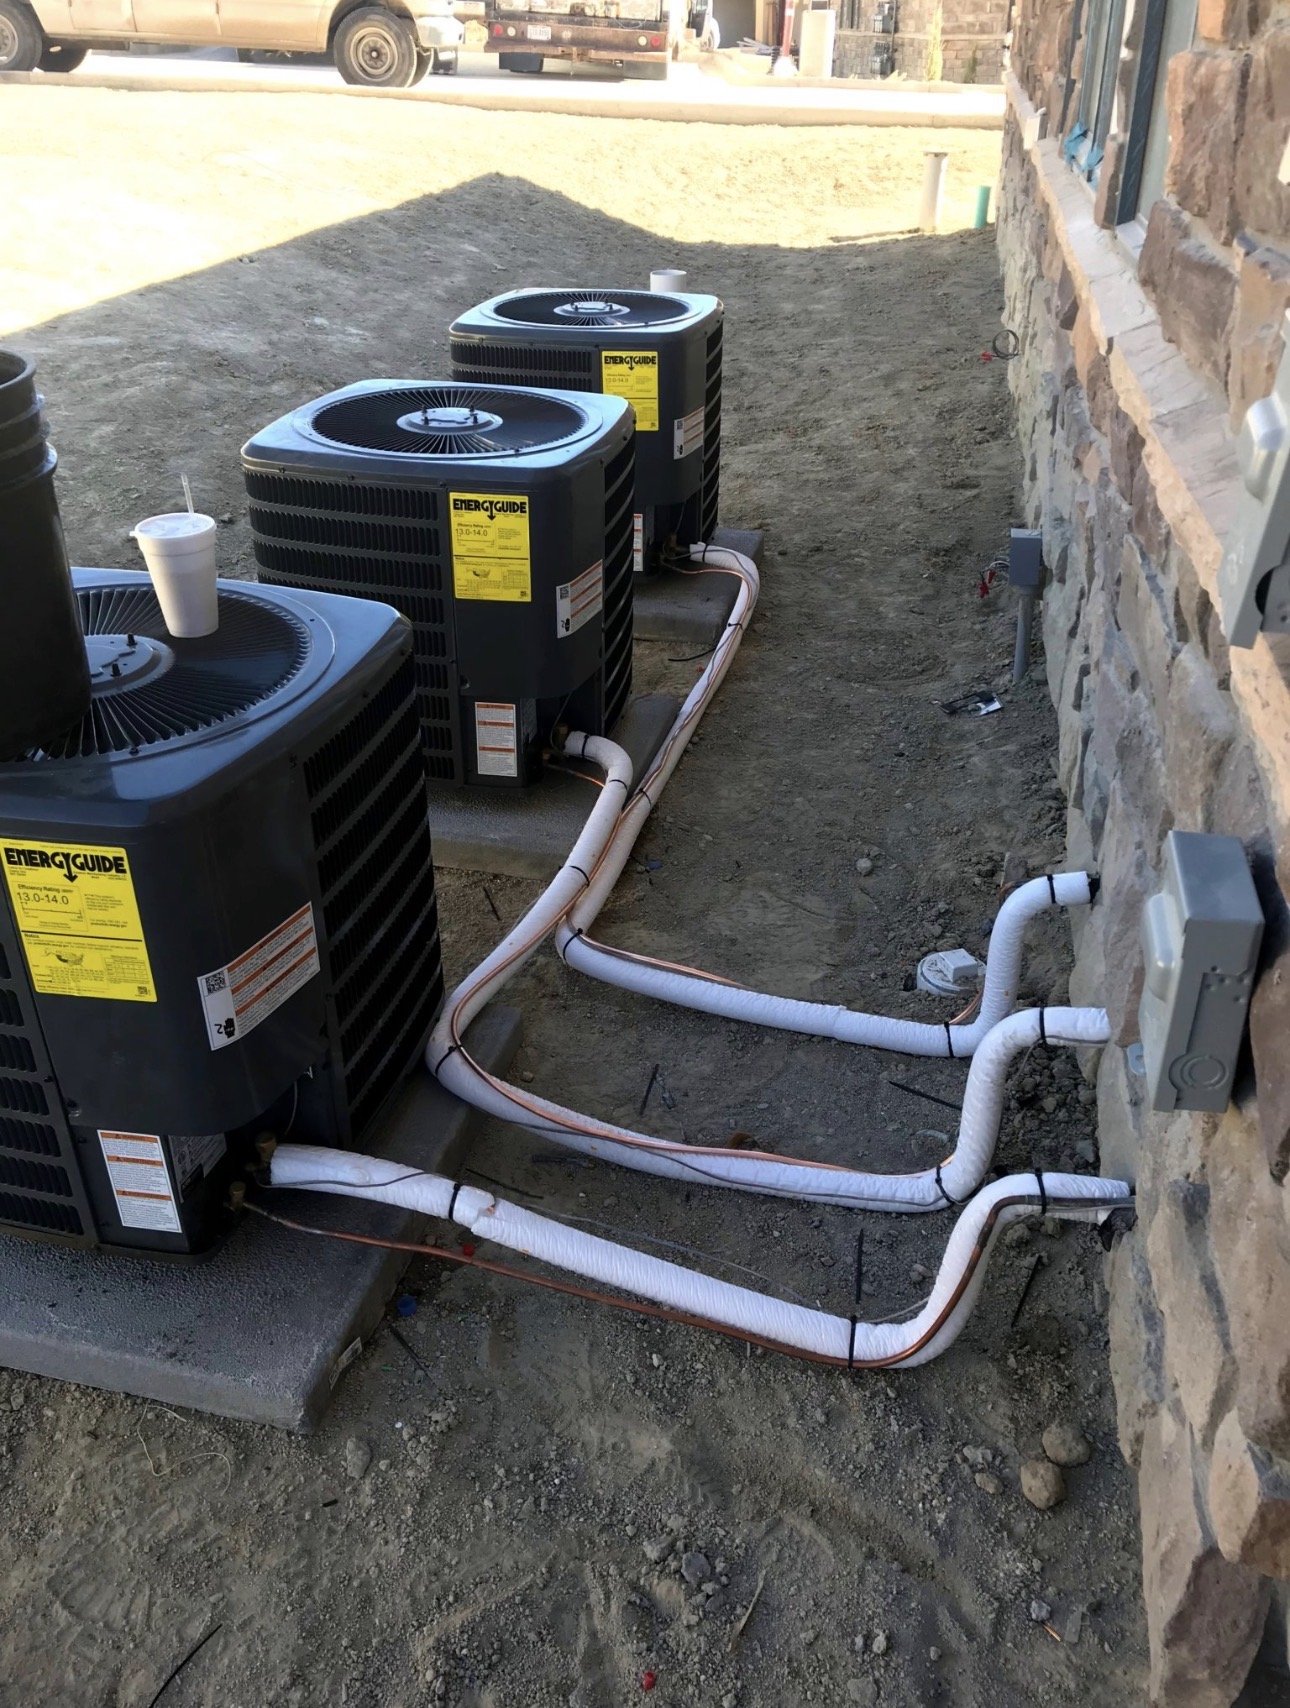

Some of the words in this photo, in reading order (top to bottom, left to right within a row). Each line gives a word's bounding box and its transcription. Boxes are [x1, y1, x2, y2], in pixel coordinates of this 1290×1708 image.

[453, 498, 527, 514] ENERGYGUIDE
[4, 848, 127, 875] ENERGYGUIDE
[16, 892, 69, 905] 13.0-14.0
